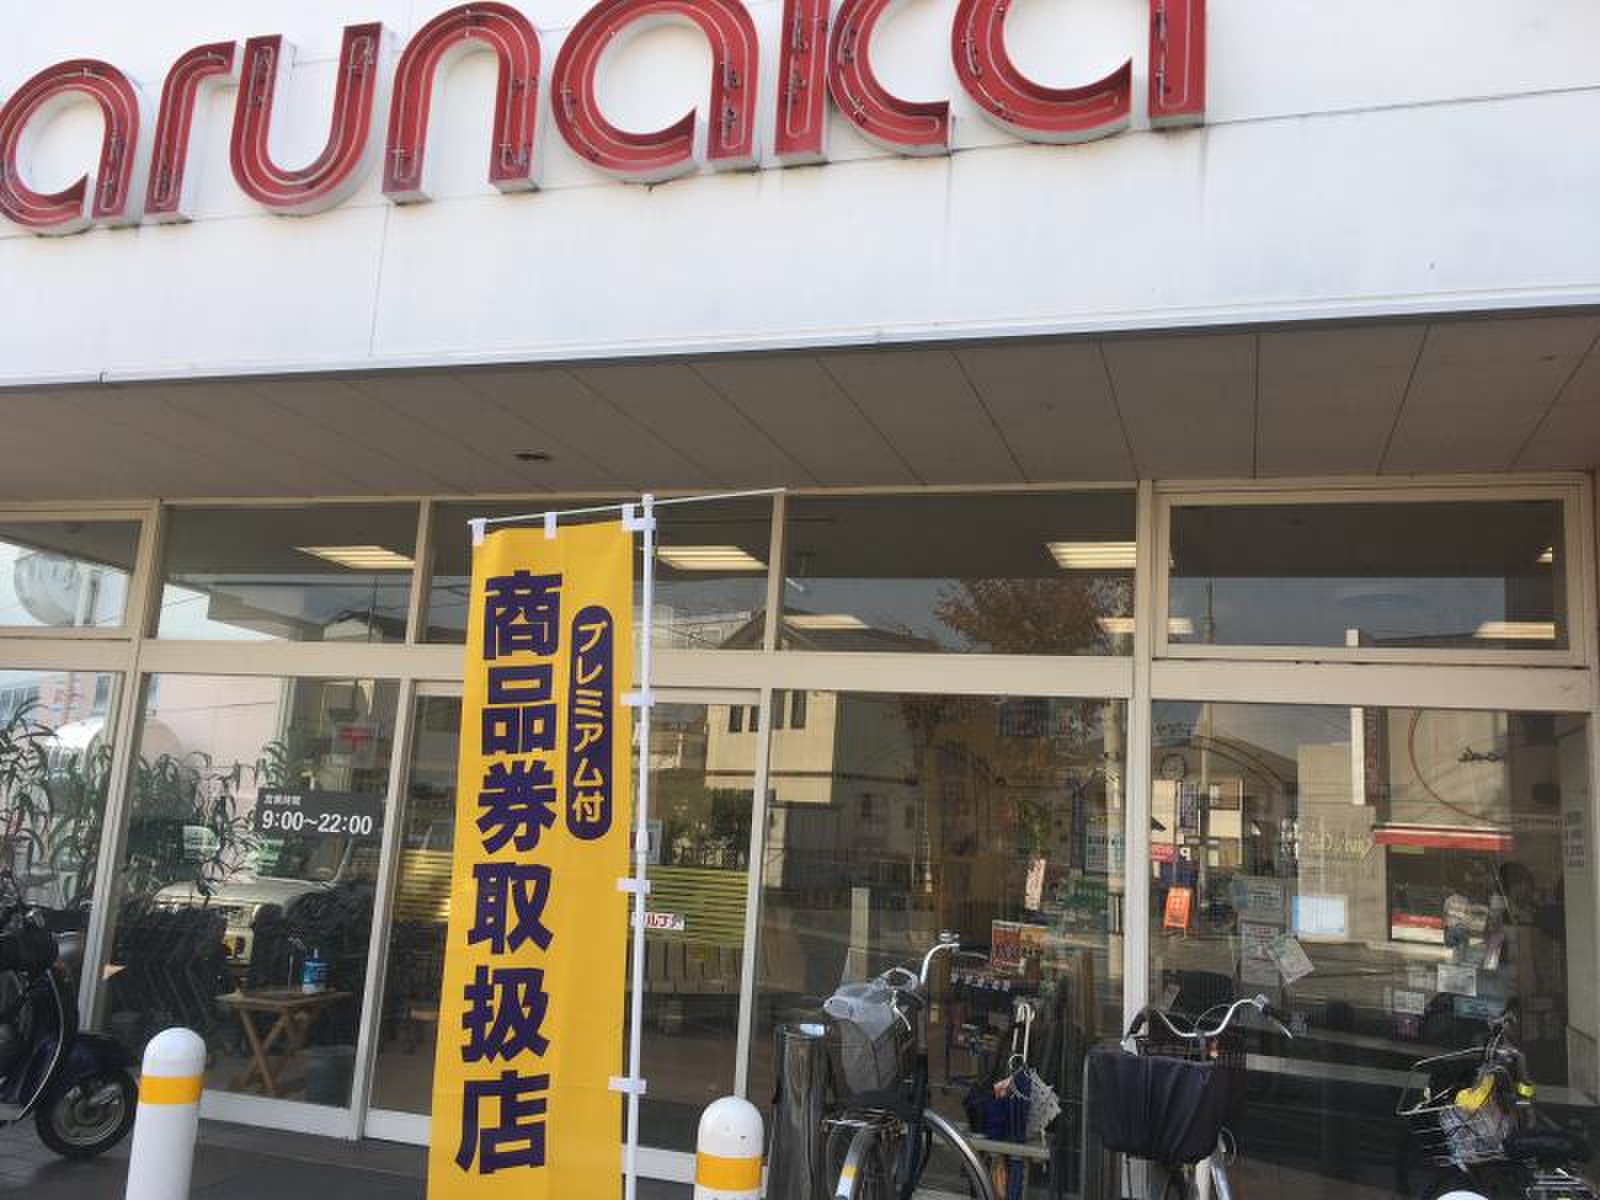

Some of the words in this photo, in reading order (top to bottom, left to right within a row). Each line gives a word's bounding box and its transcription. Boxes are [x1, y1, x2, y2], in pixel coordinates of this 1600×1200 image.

[455, 569, 563, 1175] 商品券取扱店
[573, 620, 609, 823] プレミアム付
